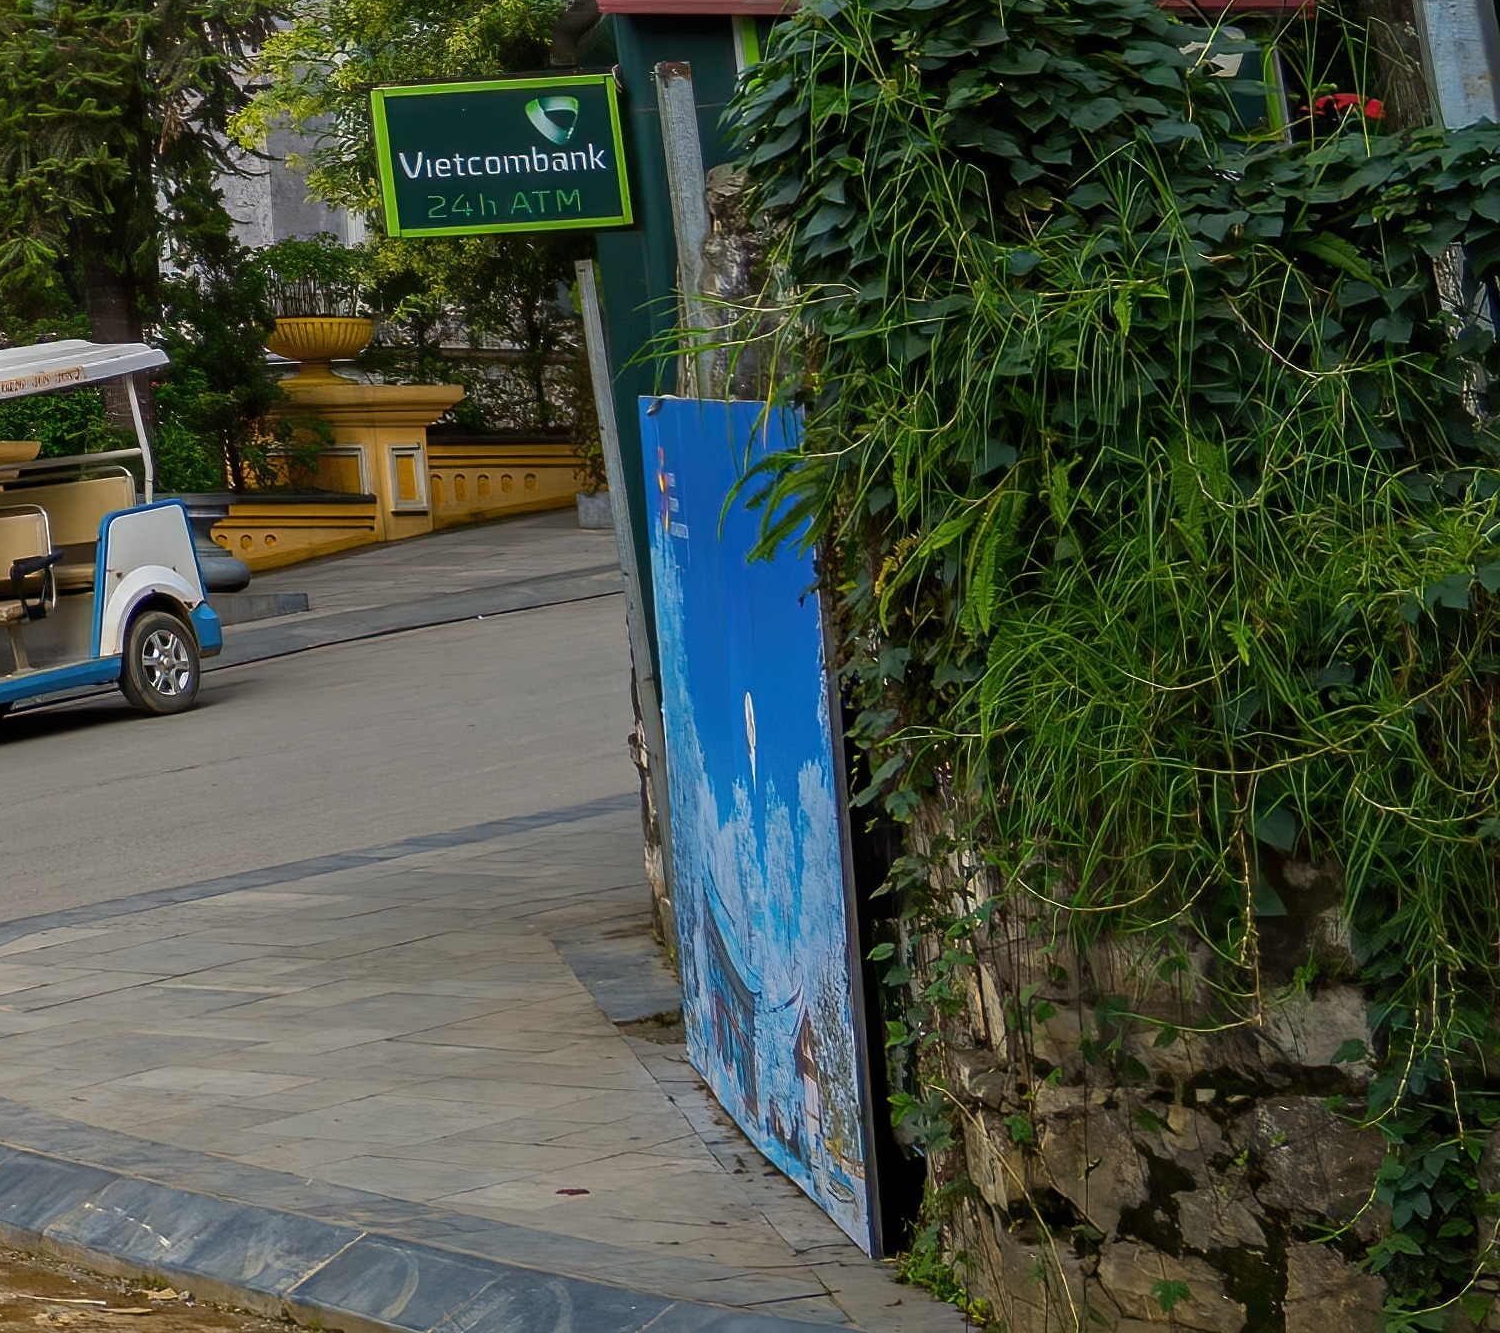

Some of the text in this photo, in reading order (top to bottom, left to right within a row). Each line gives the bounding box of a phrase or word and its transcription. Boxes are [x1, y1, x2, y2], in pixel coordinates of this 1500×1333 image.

[398, 143, 608, 179] Vietcombank
[427, 189, 581, 218] 24h ATM
